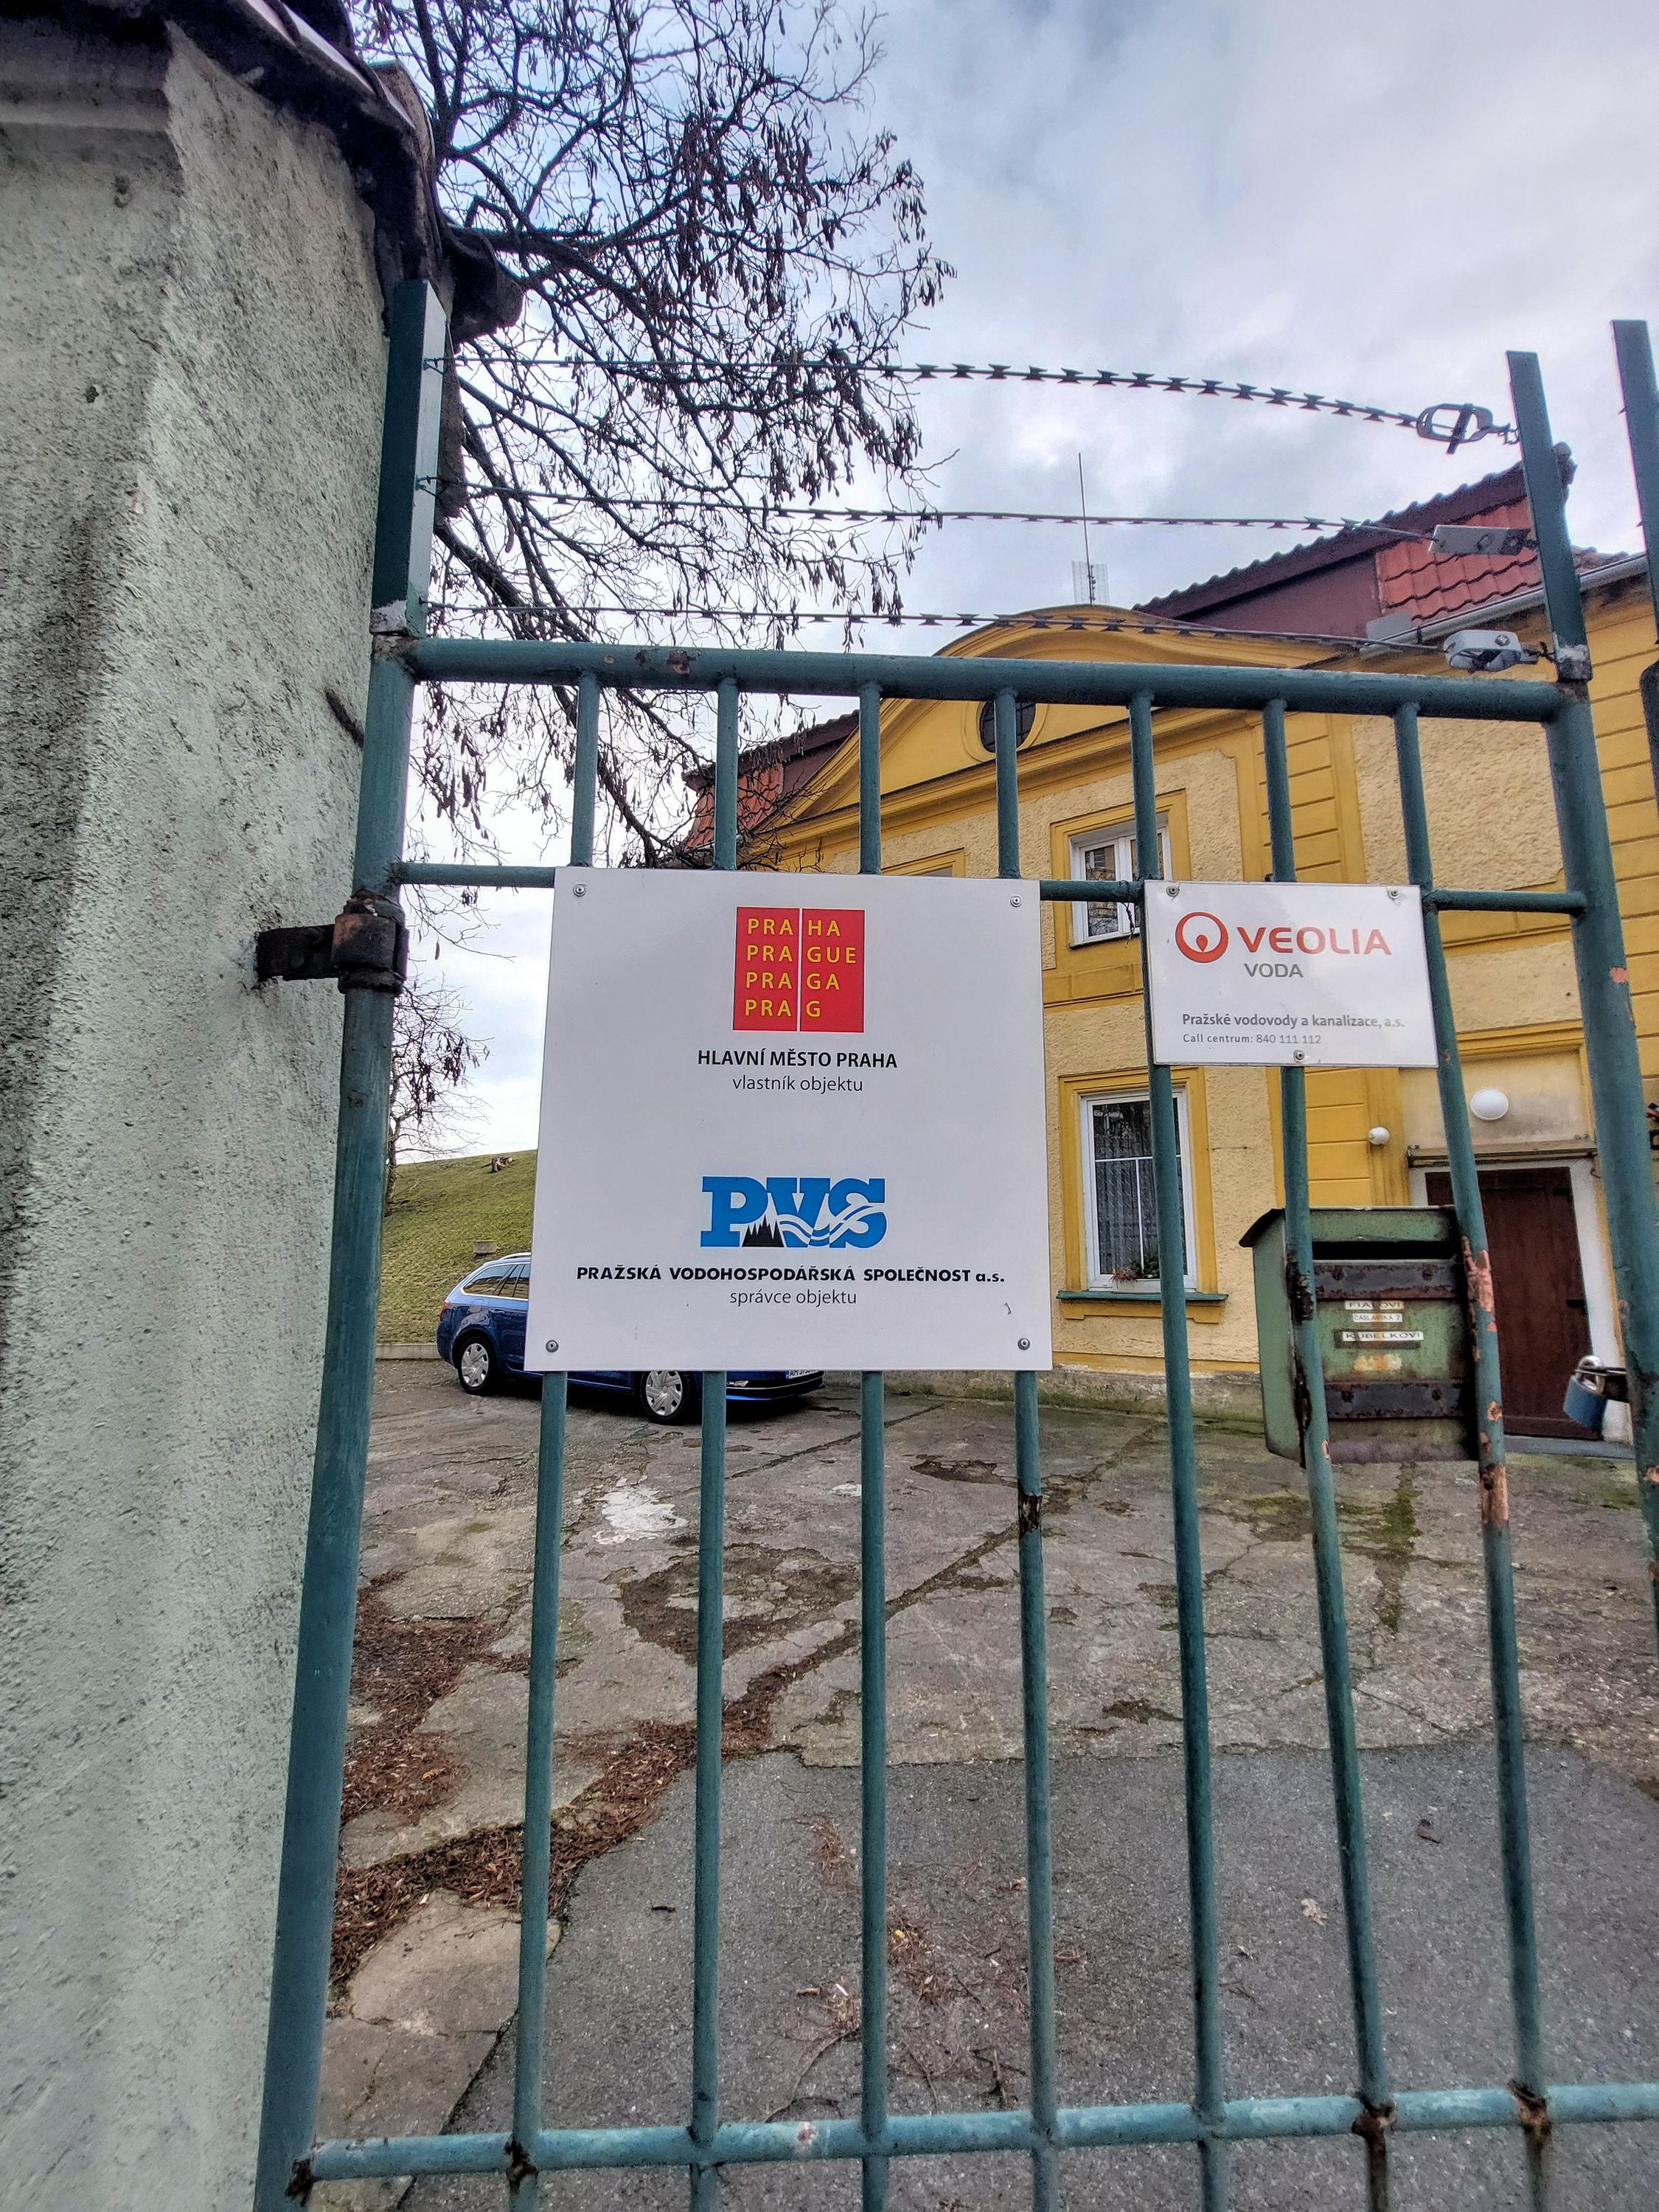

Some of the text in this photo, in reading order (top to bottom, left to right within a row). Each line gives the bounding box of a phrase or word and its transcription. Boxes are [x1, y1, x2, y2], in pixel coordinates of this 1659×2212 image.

[1237, 926, 1393, 956] VEOLIA
[1244, 962, 1304, 978] VODA
[1183, 1012, 1405, 1029] Pražské vodovody a kanalizace, a.s.
[1183, 1034, 1321, 1044] Call centrum: 840 111 112
[698, 1048, 898, 1068] HLAVNÍ MĚSTO PRAHA
[732, 1074, 863, 1094] vlastník objektu
[700, 1176, 888, 1248] PVS
[577, 1264, 1005, 1282] PRAŽSKÁ VODOHOSPODÁŘSKÁ SPOLEČNOST a.s.
[730, 1289, 857, 1307] správce objektu
